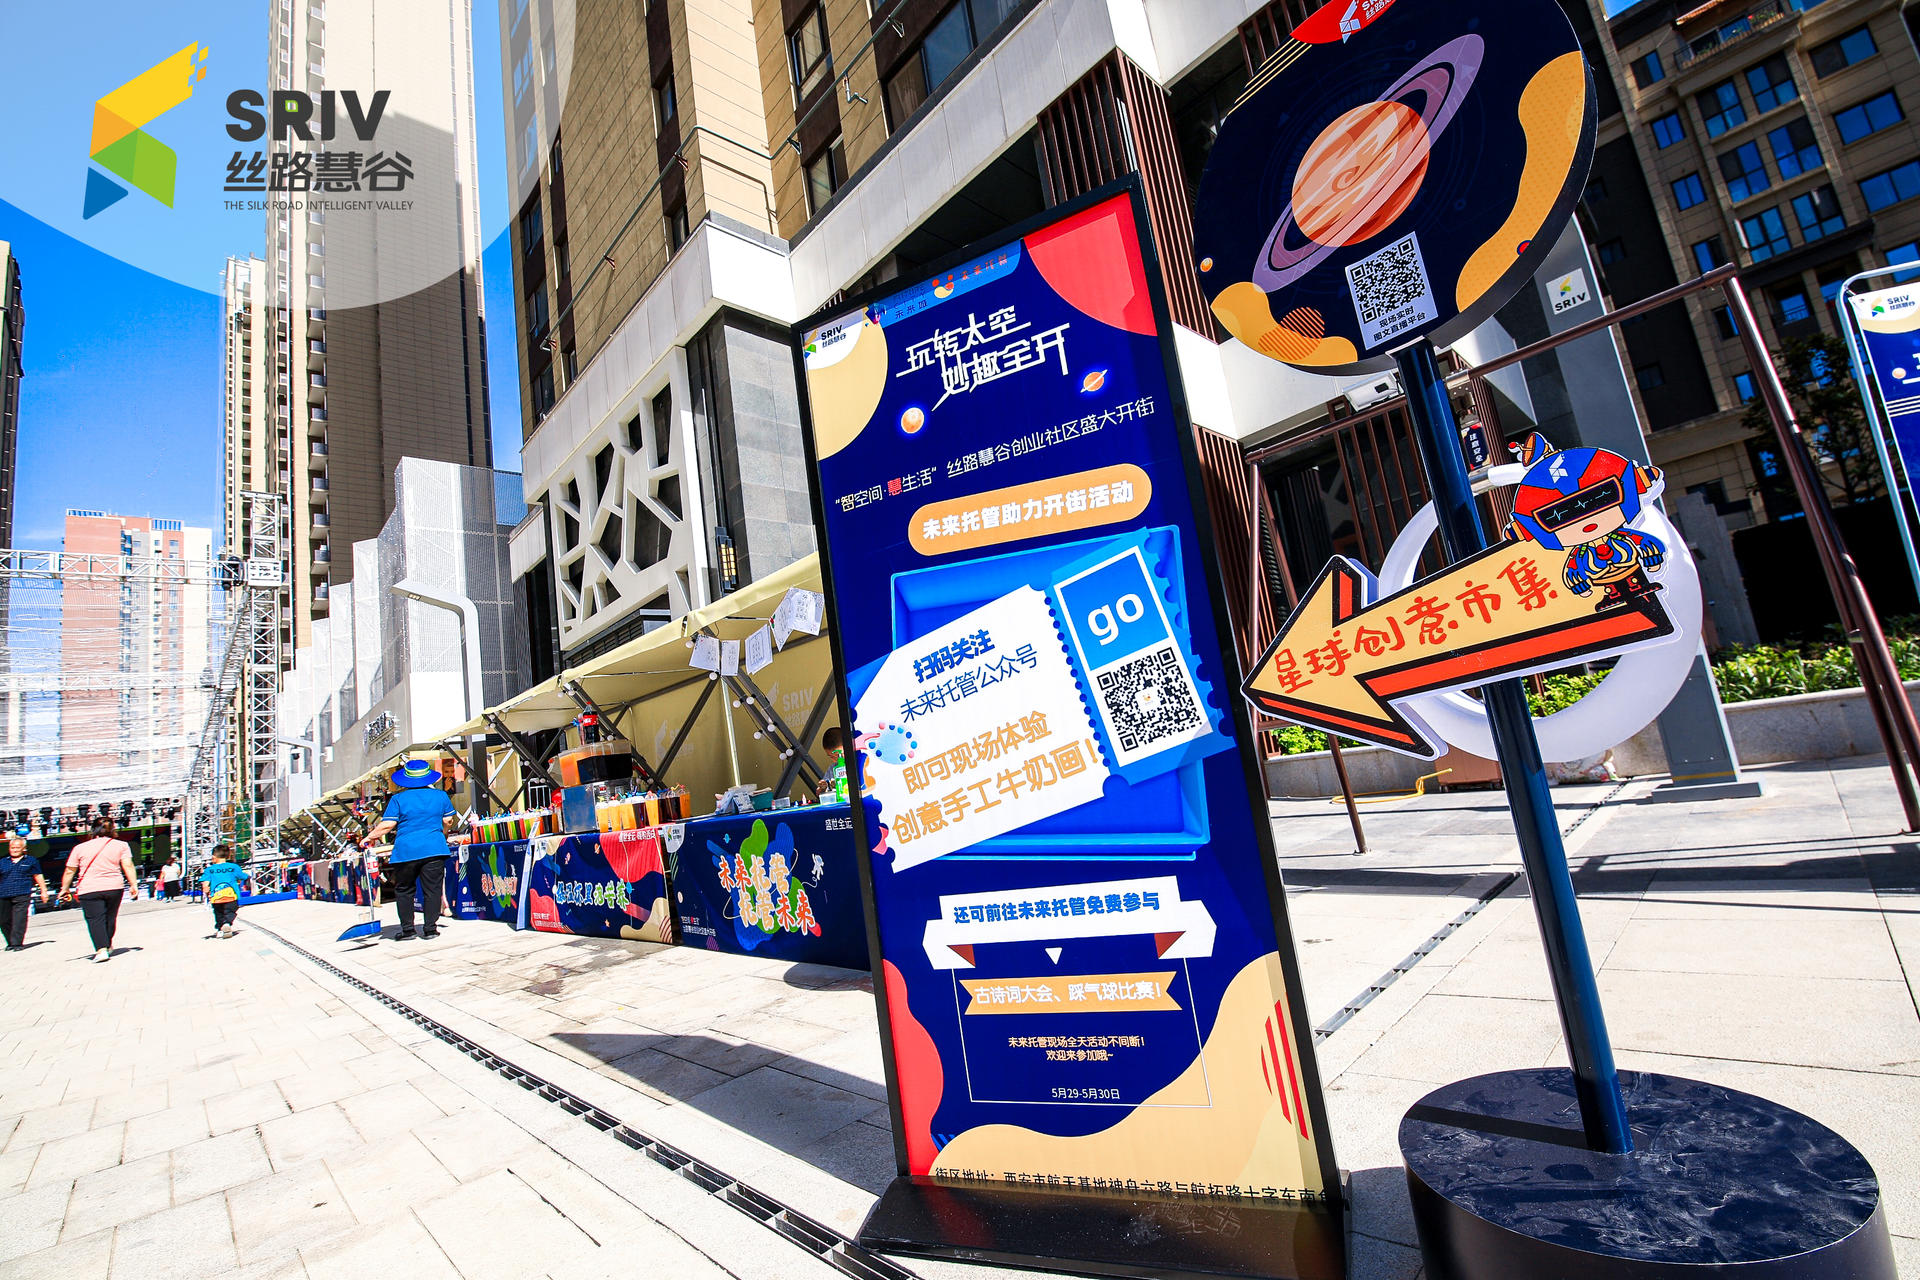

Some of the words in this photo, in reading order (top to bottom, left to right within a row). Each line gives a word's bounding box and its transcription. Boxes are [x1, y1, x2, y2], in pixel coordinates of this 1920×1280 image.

[1379, 306, 1414, 328] 现场实时
[1554, 292, 1585, 311] SRIV
[1887, 294, 1910, 305] SRIV
[821, 324, 842, 340] SRIV
[896, 305, 1031, 378] 玩转太空
[1373, 312, 1426, 341] 图文直播平台
[931, 323, 1070, 411] 妙趣全开
[946, 397, 1155, 478] 丝路慧谷创业社区盛大开街
[922, 479, 1135, 541] 未来托管助力开街活动
[1087, 591, 1145, 645] go
[1273, 556, 1558, 694] 星球创意市集
[913, 628, 996, 684] 扫码关注
[783, 688, 814, 711] SRIV
[900, 643, 1038, 723] 未来托管公众号
[902, 710, 1052, 794] 即可现场体验
[891, 739, 1099, 844] 创意手工牛奶画！
[718, 852, 790, 895] 未来托管
[738, 889, 816, 936] 托管未来
[953, 891, 1160, 924] 还可前往未来托管免费参与
[973, 980, 1161, 1005] 古诗词大会、踩气球比赛！
[1051, 1087, 1121, 1099] 5月29-5月30日
